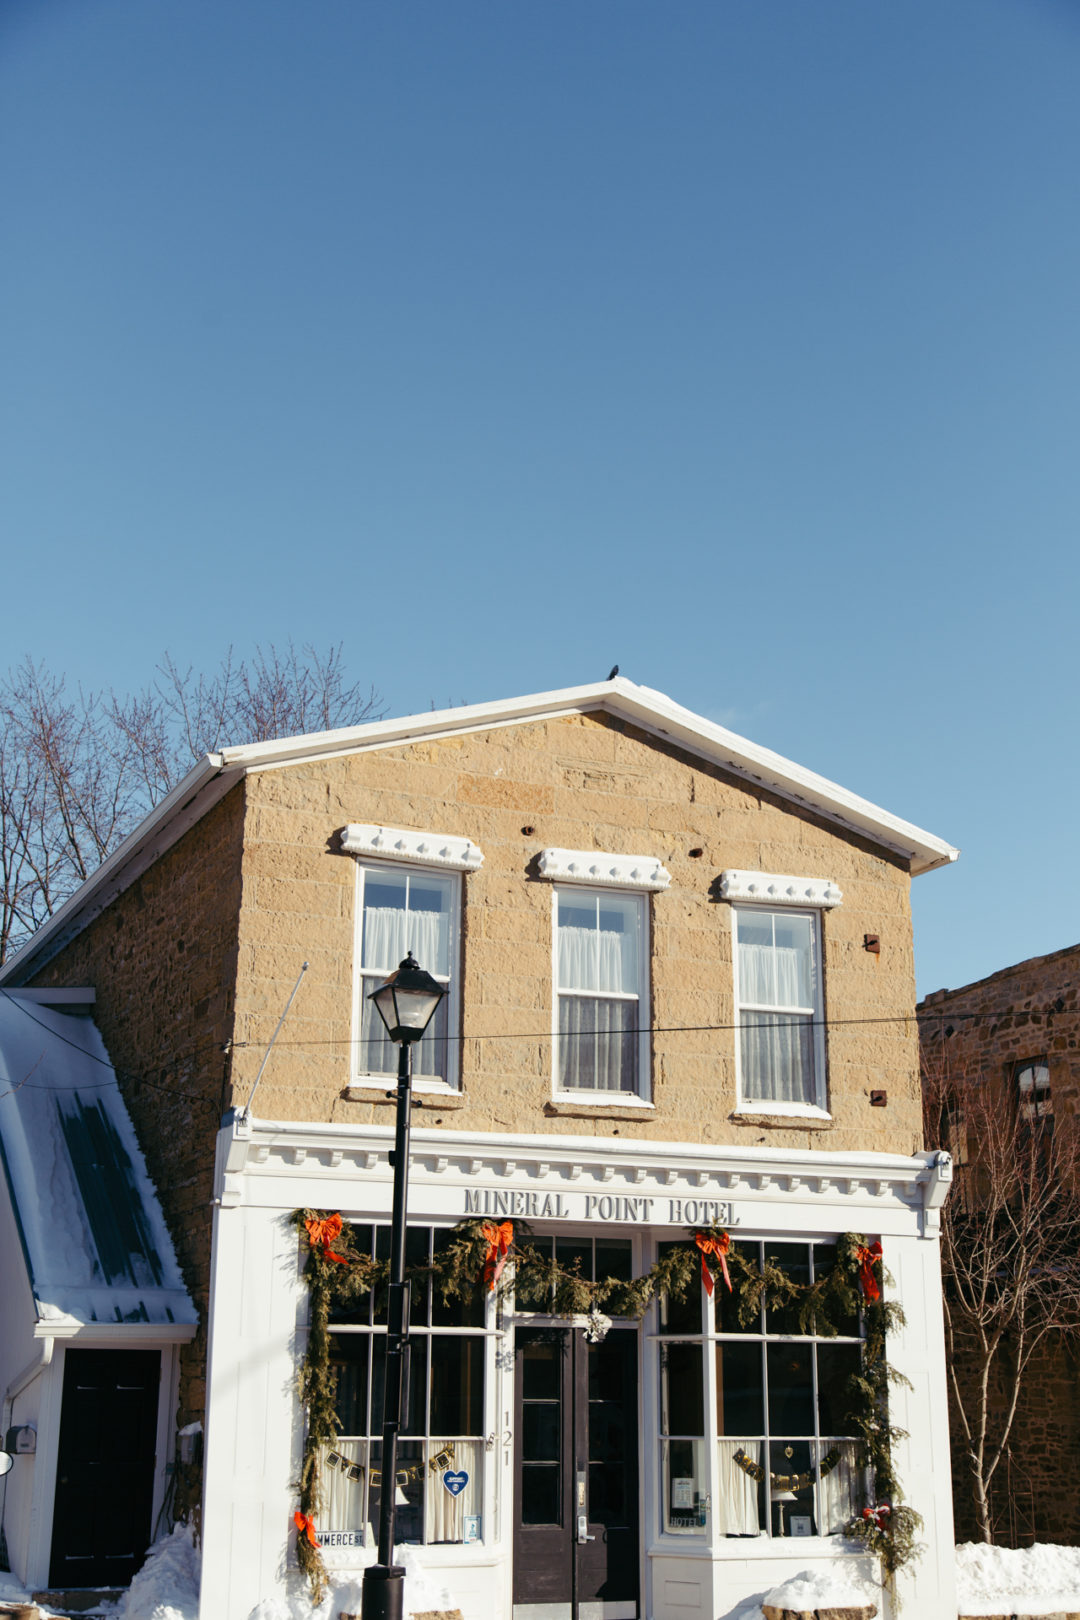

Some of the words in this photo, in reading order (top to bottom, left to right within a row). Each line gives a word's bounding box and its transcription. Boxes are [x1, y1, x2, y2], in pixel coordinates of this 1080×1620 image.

[464, 1189, 569, 1218] MINERAL
[584, 1195, 654, 1222] POINT
[668, 1199, 740, 1226] HOTEL
[315, 1533, 354, 1546] MMERCE
[354, 1535, 363, 1544] ST
